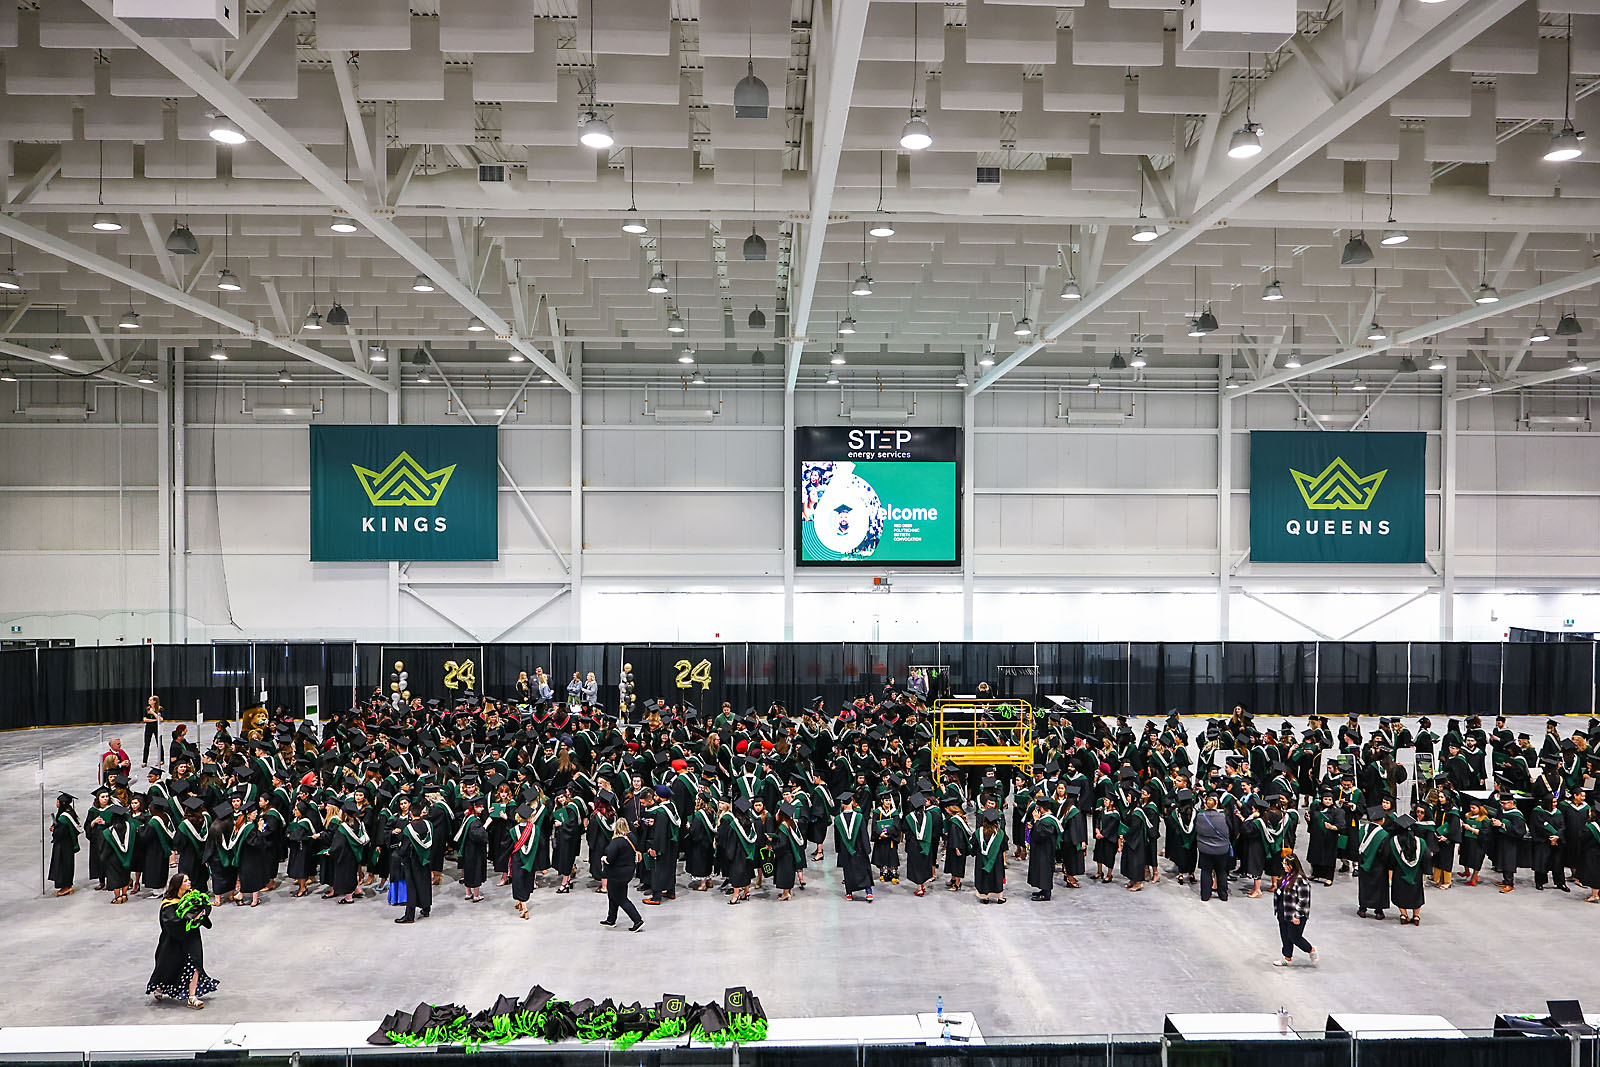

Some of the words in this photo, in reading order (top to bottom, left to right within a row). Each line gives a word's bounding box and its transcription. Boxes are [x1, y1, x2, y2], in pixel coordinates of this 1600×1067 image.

[848, 429, 912, 450] STEP
[847, 452, 876, 460] energy
[877, 451, 911, 459] services
[874, 503, 938, 521] elcome
[362, 516, 447, 532] KINGS
[1286, 519, 1391, 536] QUEENS
[443, 658, 476, 691] 24
[673, 658, 712, 691] 24
